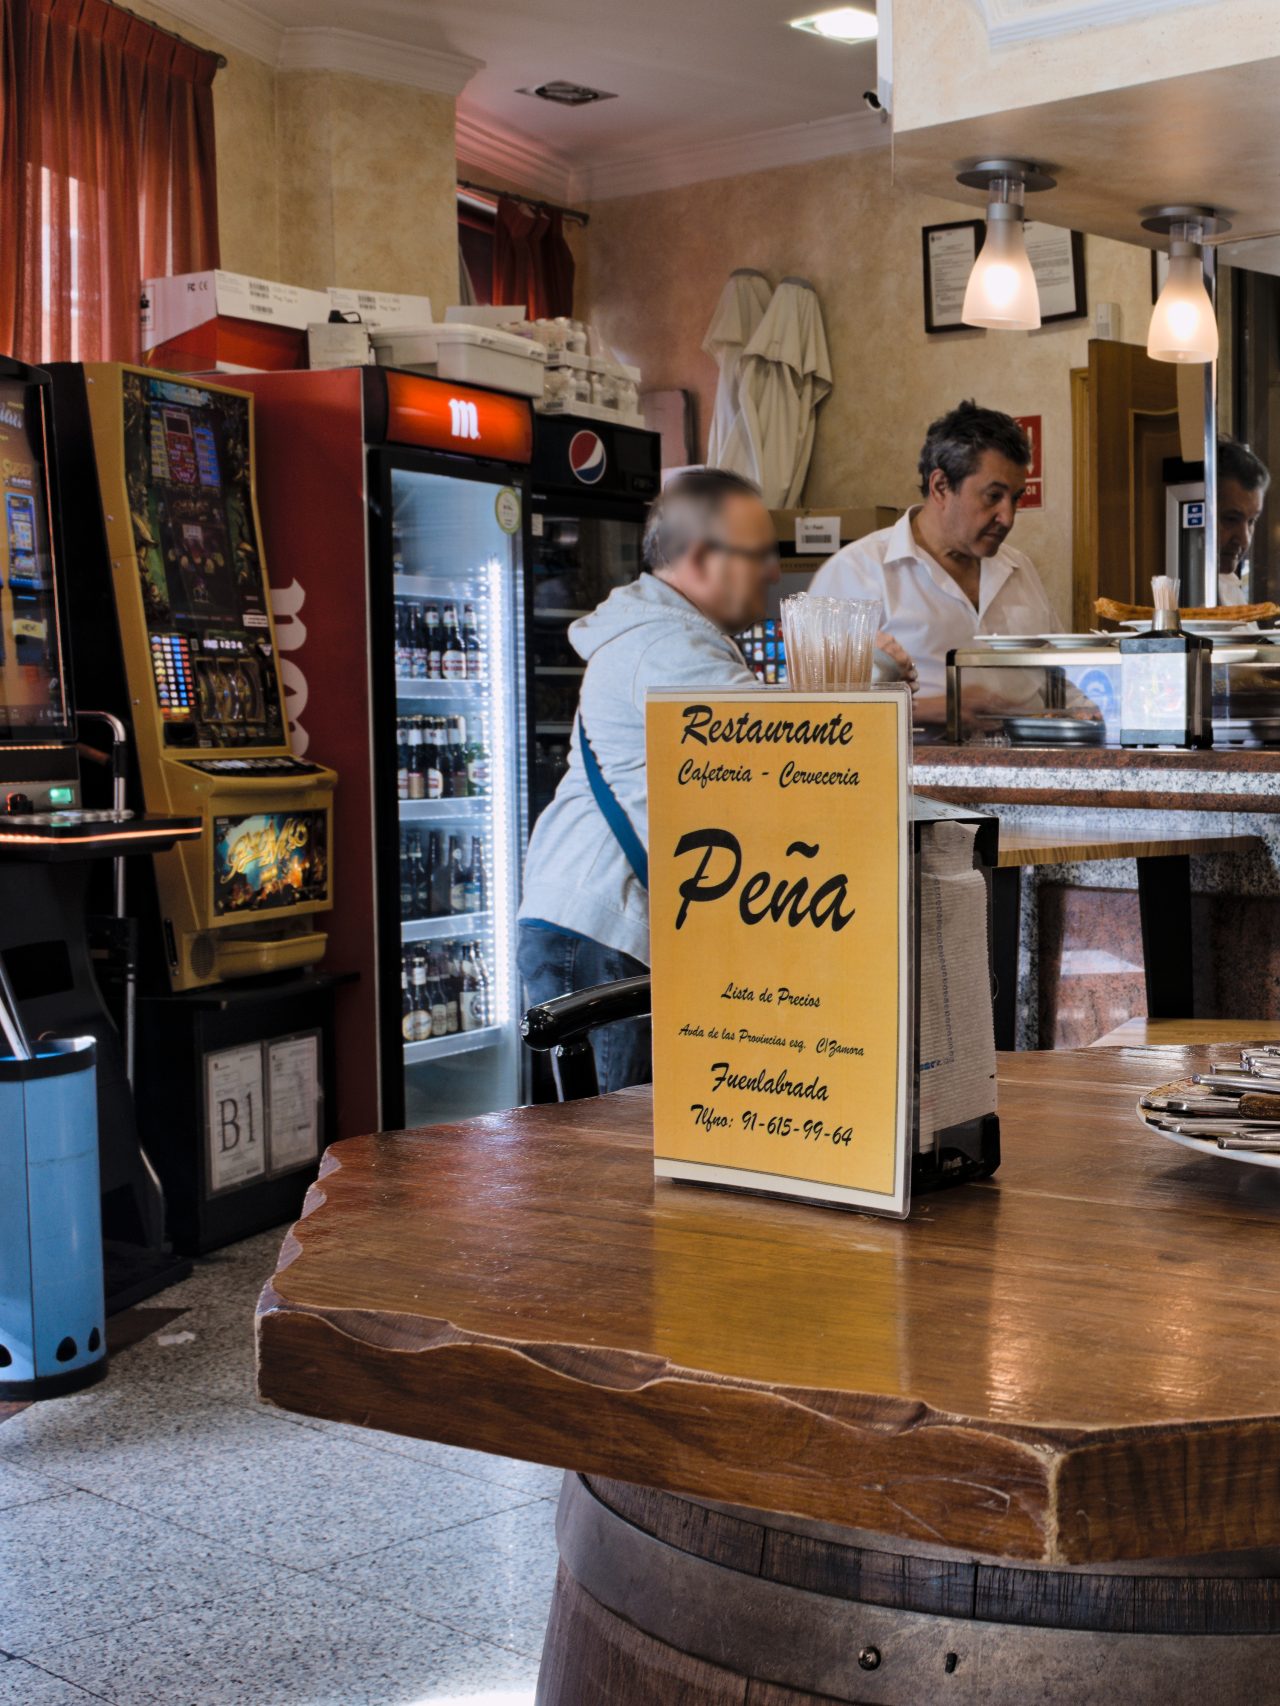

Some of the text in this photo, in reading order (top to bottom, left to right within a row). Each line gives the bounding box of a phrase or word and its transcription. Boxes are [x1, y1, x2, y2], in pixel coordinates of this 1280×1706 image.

[681, 704, 854, 746] Restaurante
[678, 758, 753, 789] Cafeteria
[778, 760, 860, 789] Cerveceria
[673, 827, 856, 933] Peña
[720, 982, 820, 1009] Lista de Precios
[678, 1023, 704, 1038] Avda
[707, 1028, 719, 1039] de
[721, 1028, 735, 1041] las
[739, 1029, 786, 1047] Provincias
[788, 1039, 806, 1053] esq.
[710, 1062, 829, 1102] Fuenlabrada
[690, 1103, 853, 1147] Tlfno: 91-615-99-64
